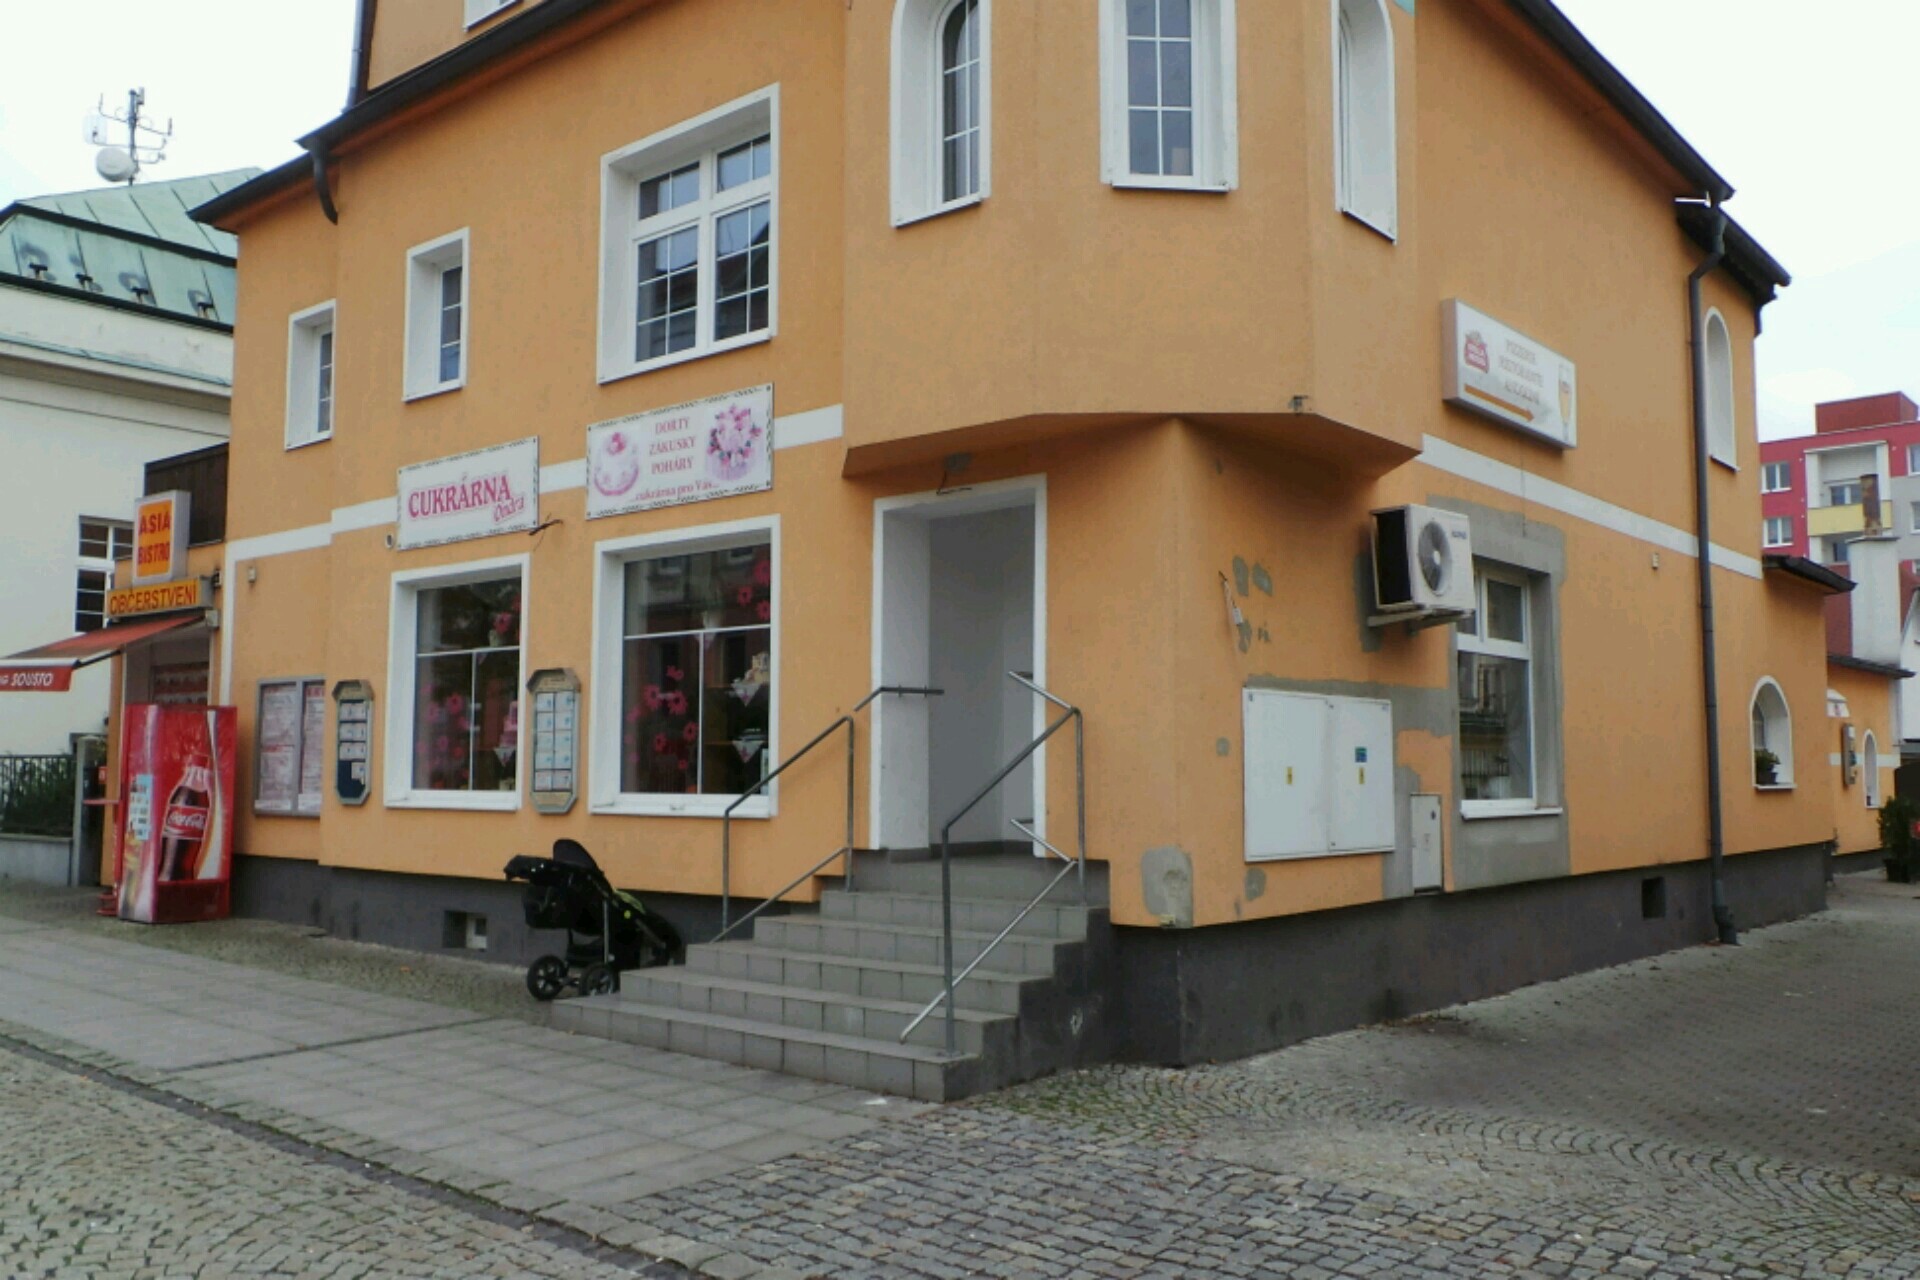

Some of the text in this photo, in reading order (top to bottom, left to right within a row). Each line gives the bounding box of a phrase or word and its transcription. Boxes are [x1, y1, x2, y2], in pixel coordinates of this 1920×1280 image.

[655, 417, 691, 435] DORTY
[408, 473, 511, 518] CUKRÁRNA
[138, 511, 171, 536] ASIA
[137, 541, 171, 565] BISTRO
[11, 672, 54, 687] SOUSTO
